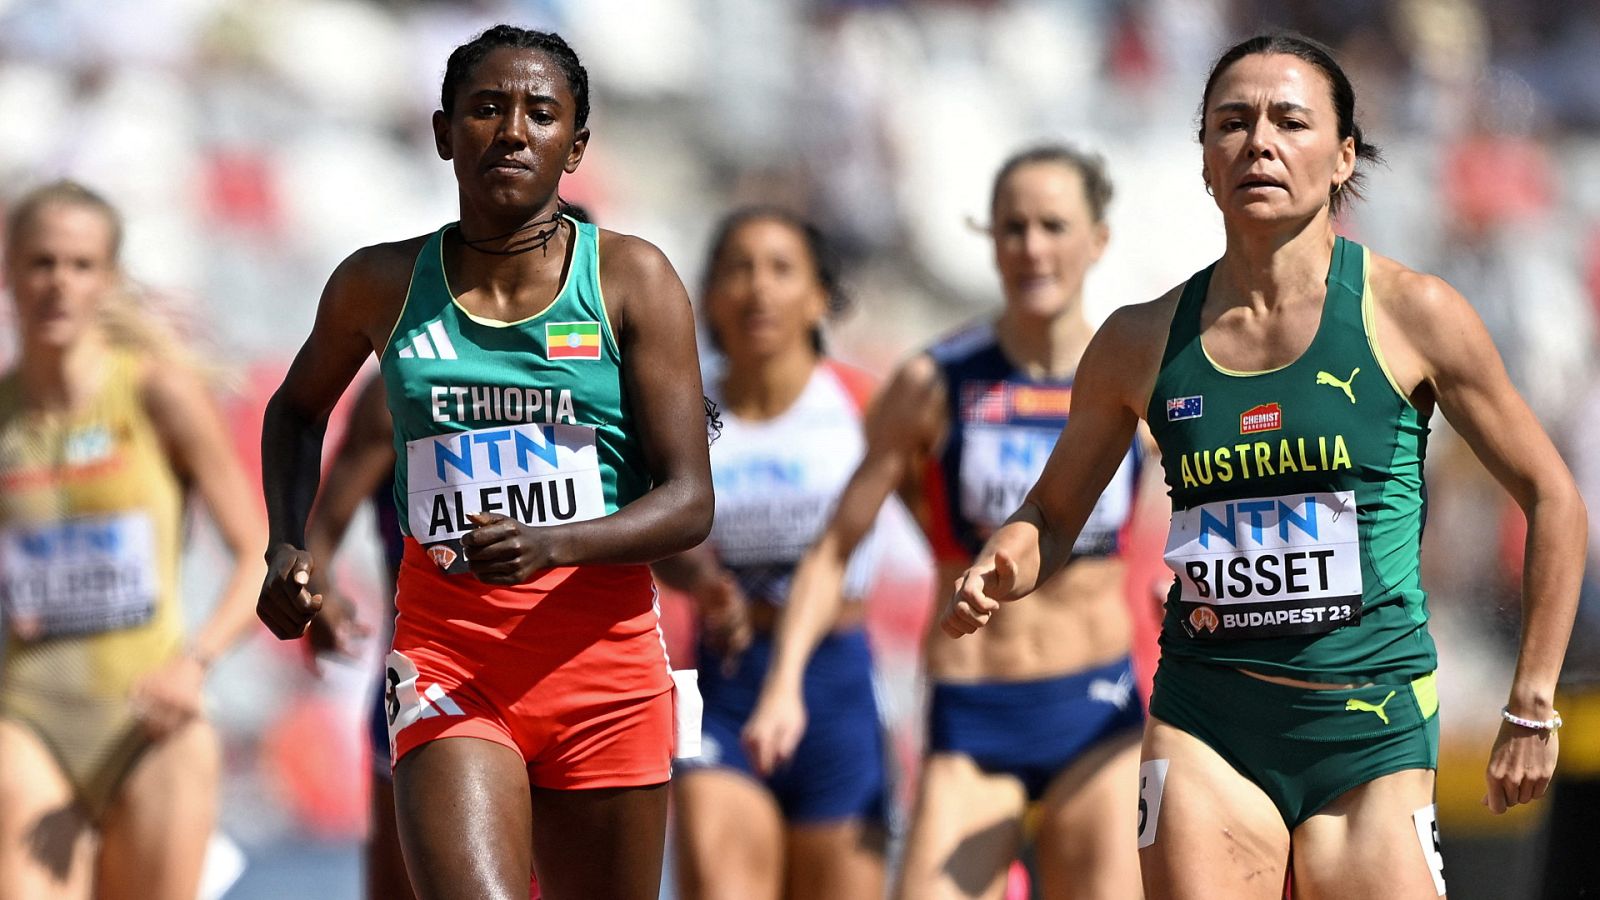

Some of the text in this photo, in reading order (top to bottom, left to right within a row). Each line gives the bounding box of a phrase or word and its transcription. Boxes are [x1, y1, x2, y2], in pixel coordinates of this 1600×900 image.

[431, 386, 577, 425] ETHIOPIA
[1243, 412, 1279, 425] CHEMIST
[433, 426, 559, 483] NTN
[1181, 435, 1352, 488] AUSTRALIA
[428, 478, 577, 536] ALEMU
[1199, 496, 1318, 550] NTN
[1185, 550, 1335, 599] BISSET
[1223, 605, 1351, 628] BUDAPEST 23
